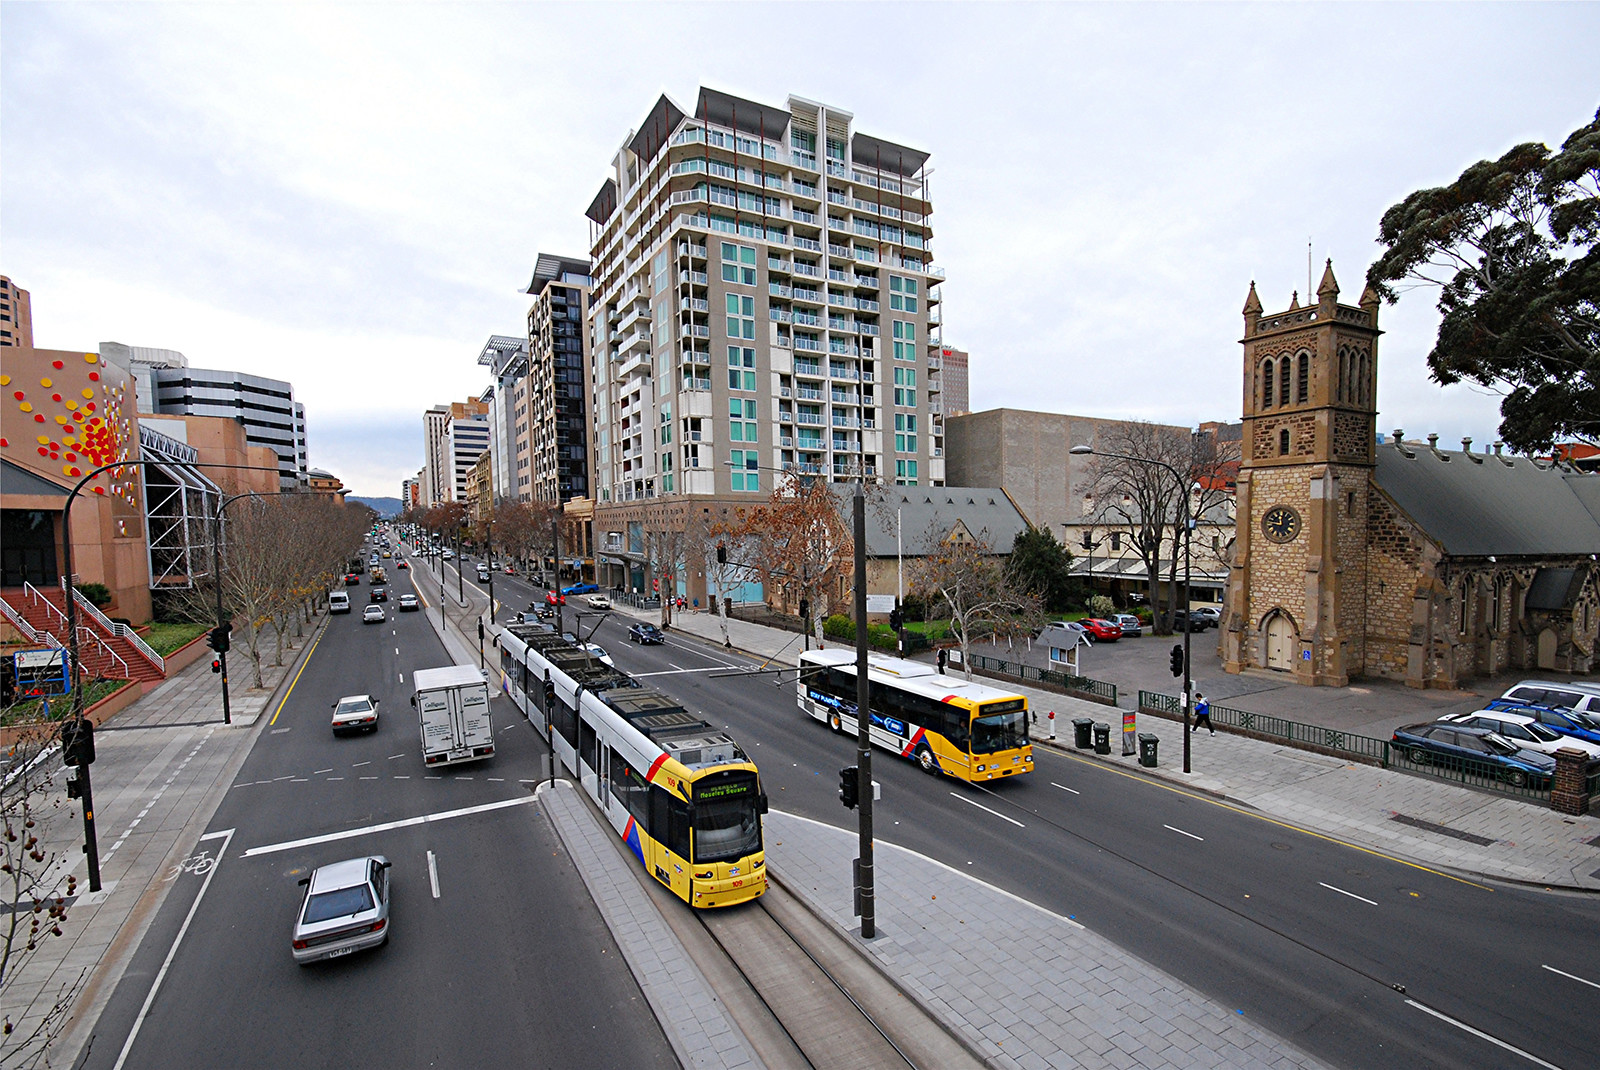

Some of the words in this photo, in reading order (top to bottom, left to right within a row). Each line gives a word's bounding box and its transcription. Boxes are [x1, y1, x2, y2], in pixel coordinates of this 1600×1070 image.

[700, 790, 725, 799] Moseley
[726, 787, 747, 795] Square
[732, 880, 743, 888] 109
